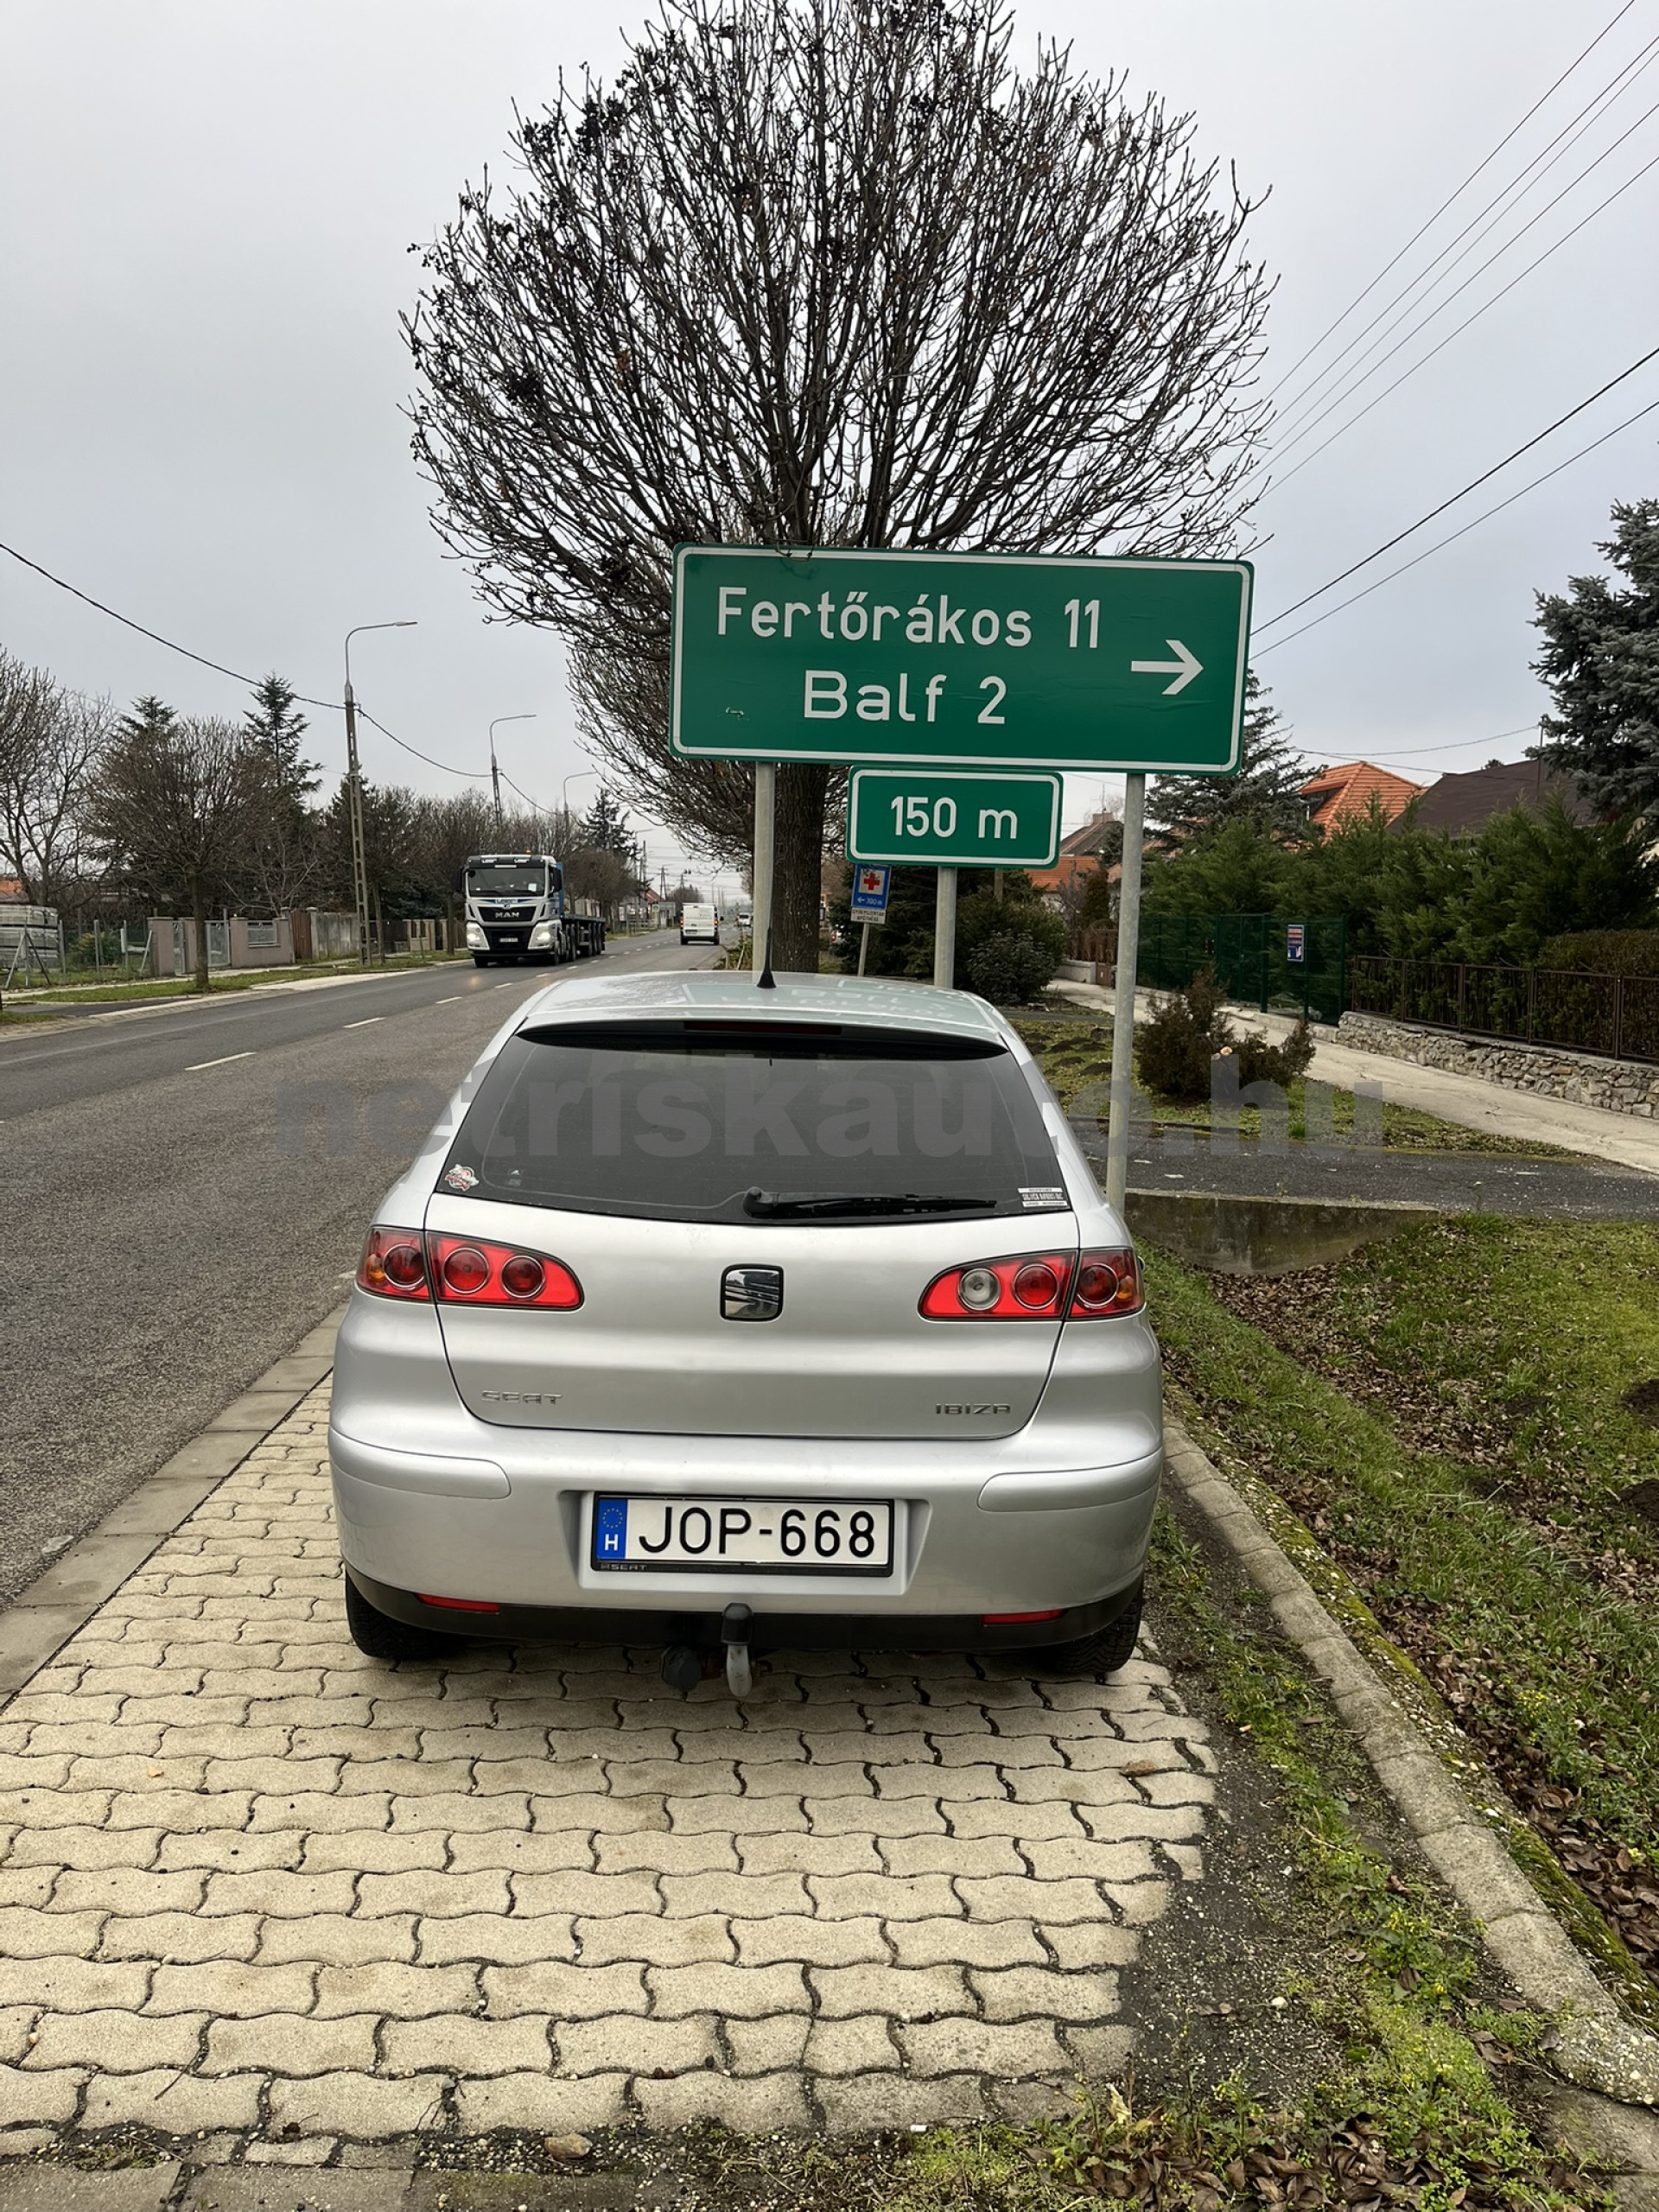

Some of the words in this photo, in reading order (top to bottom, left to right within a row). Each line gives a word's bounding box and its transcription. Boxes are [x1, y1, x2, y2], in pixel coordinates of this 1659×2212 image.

[717, 587, 1032, 647] Fertőrákos
[1064, 599, 1101, 649] 11
[804, 669, 948, 722] Balf
[976, 675, 1007, 725] 2
[891, 796, 957, 838] 150
[978, 809, 1018, 839] m
[481, 1389, 563, 1405] SEAT
[935, 1403, 1012, 1414] IBIZA
[603, 1534, 619, 1551] H
[639, 1506, 875, 1558] JOP-668
